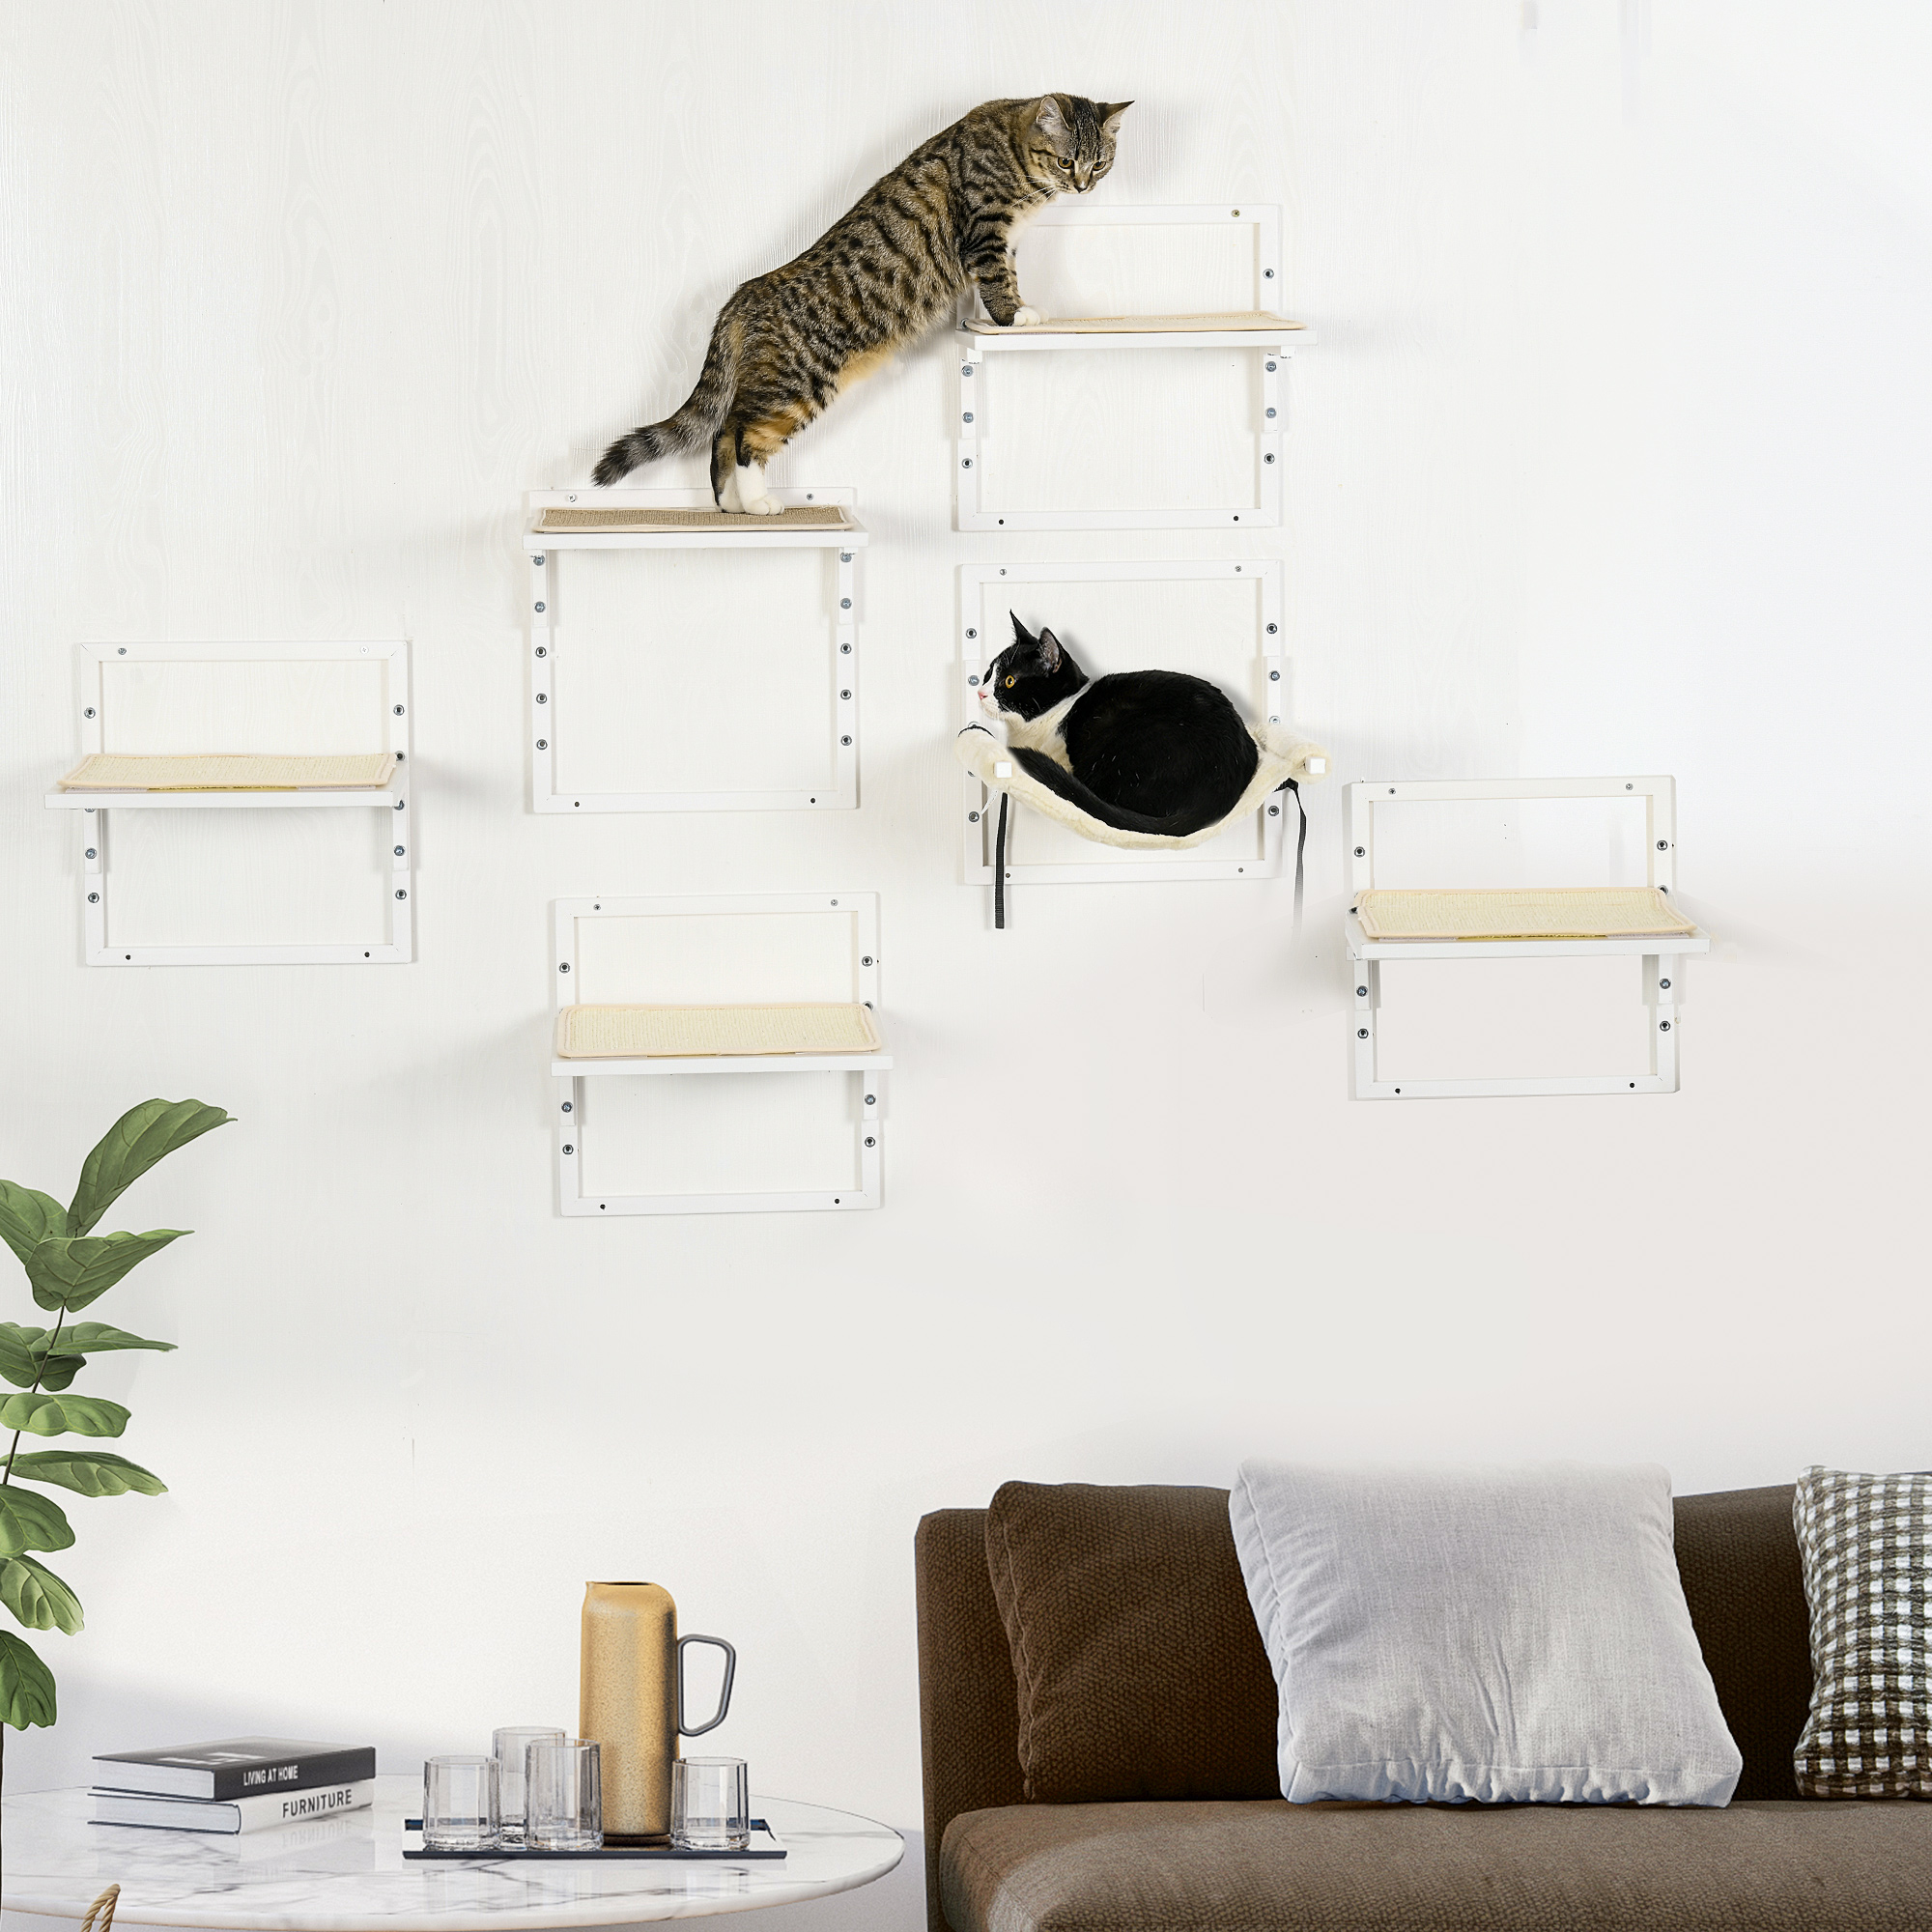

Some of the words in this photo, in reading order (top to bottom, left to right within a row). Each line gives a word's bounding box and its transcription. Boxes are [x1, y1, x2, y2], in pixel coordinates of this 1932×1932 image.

[243, 1770, 267, 1786] LIVING
[267, 1768, 277, 1782] AT
[277, 1765, 298, 1781] HOME
[282, 1789, 352, 1818] FURNITURE
